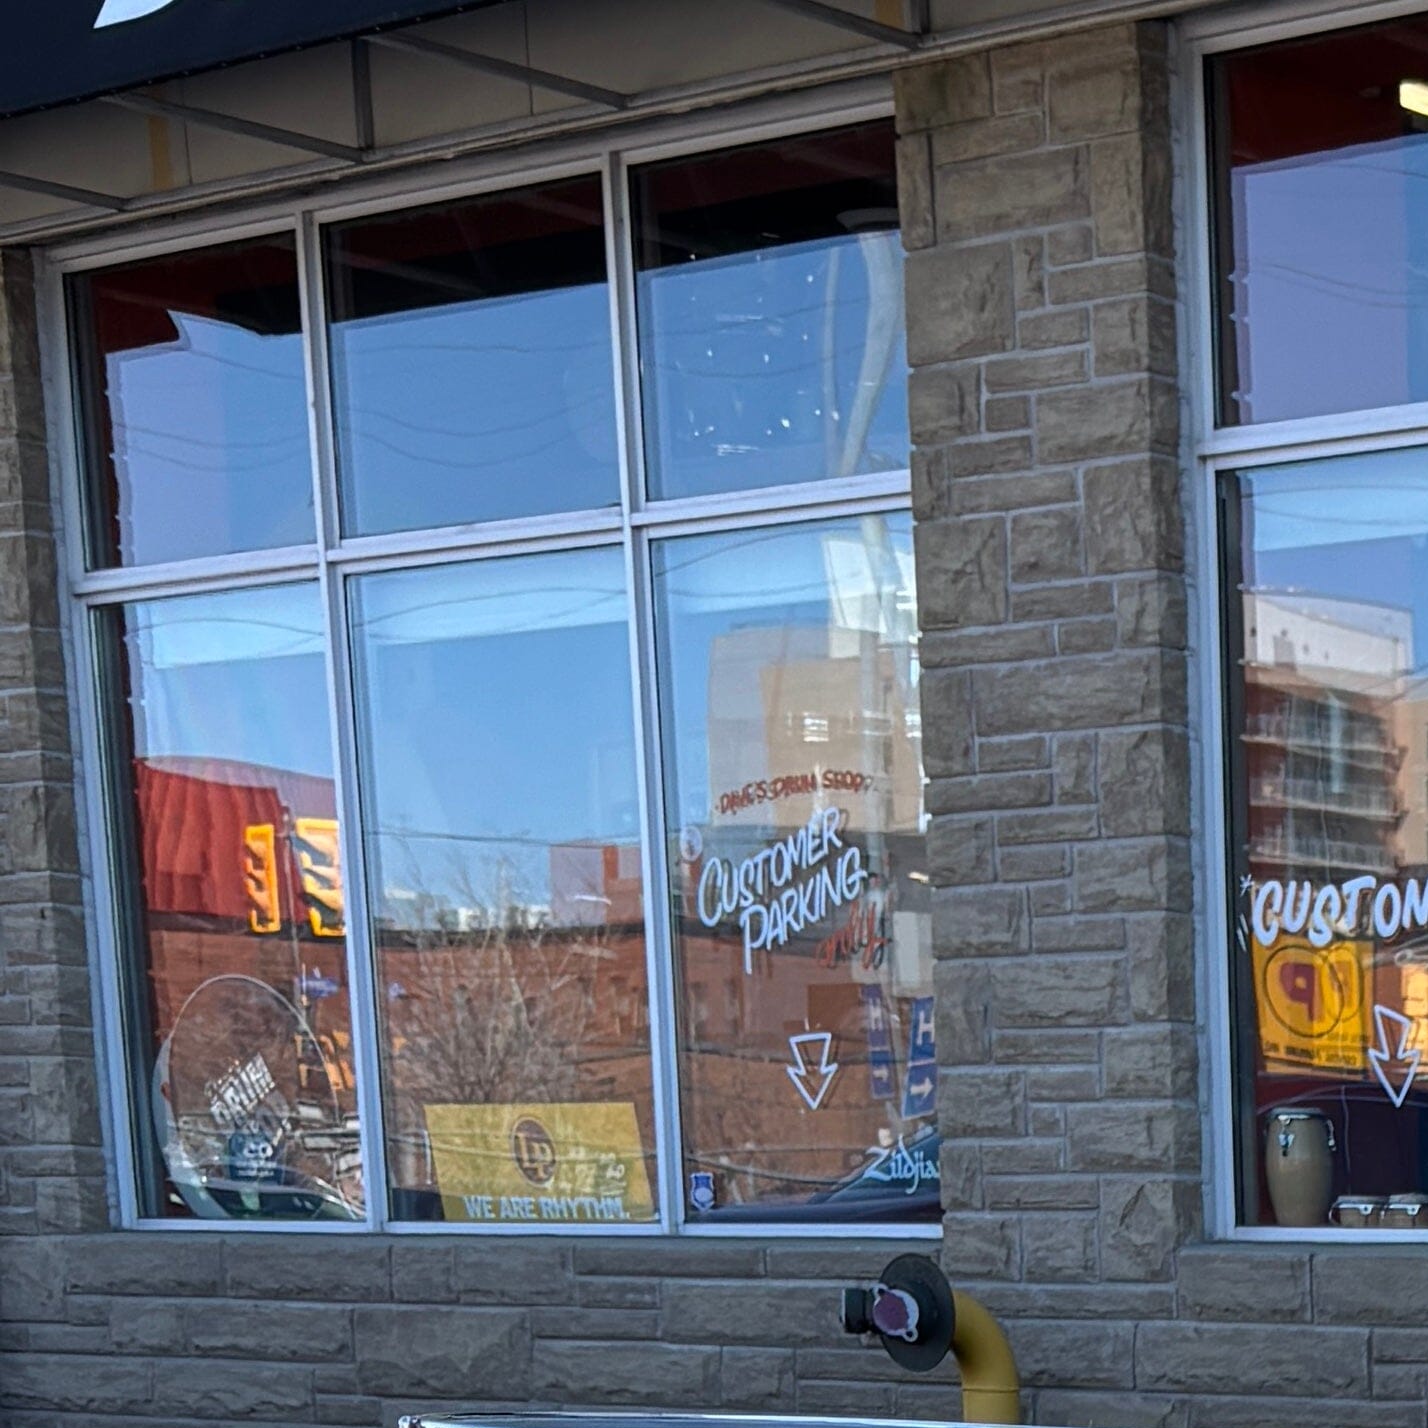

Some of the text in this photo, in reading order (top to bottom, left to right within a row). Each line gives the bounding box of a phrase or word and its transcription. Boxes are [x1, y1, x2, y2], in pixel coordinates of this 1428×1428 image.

[822, 769, 867, 792] SHOP
[698, 806, 843, 927] CUSTOMER
[740, 846, 868, 975] PARKING
[865, 1133, 941, 1195] Zildjia
[464, 1197, 496, 1219] WE
[501, 1197, 540, 1219] ARE
